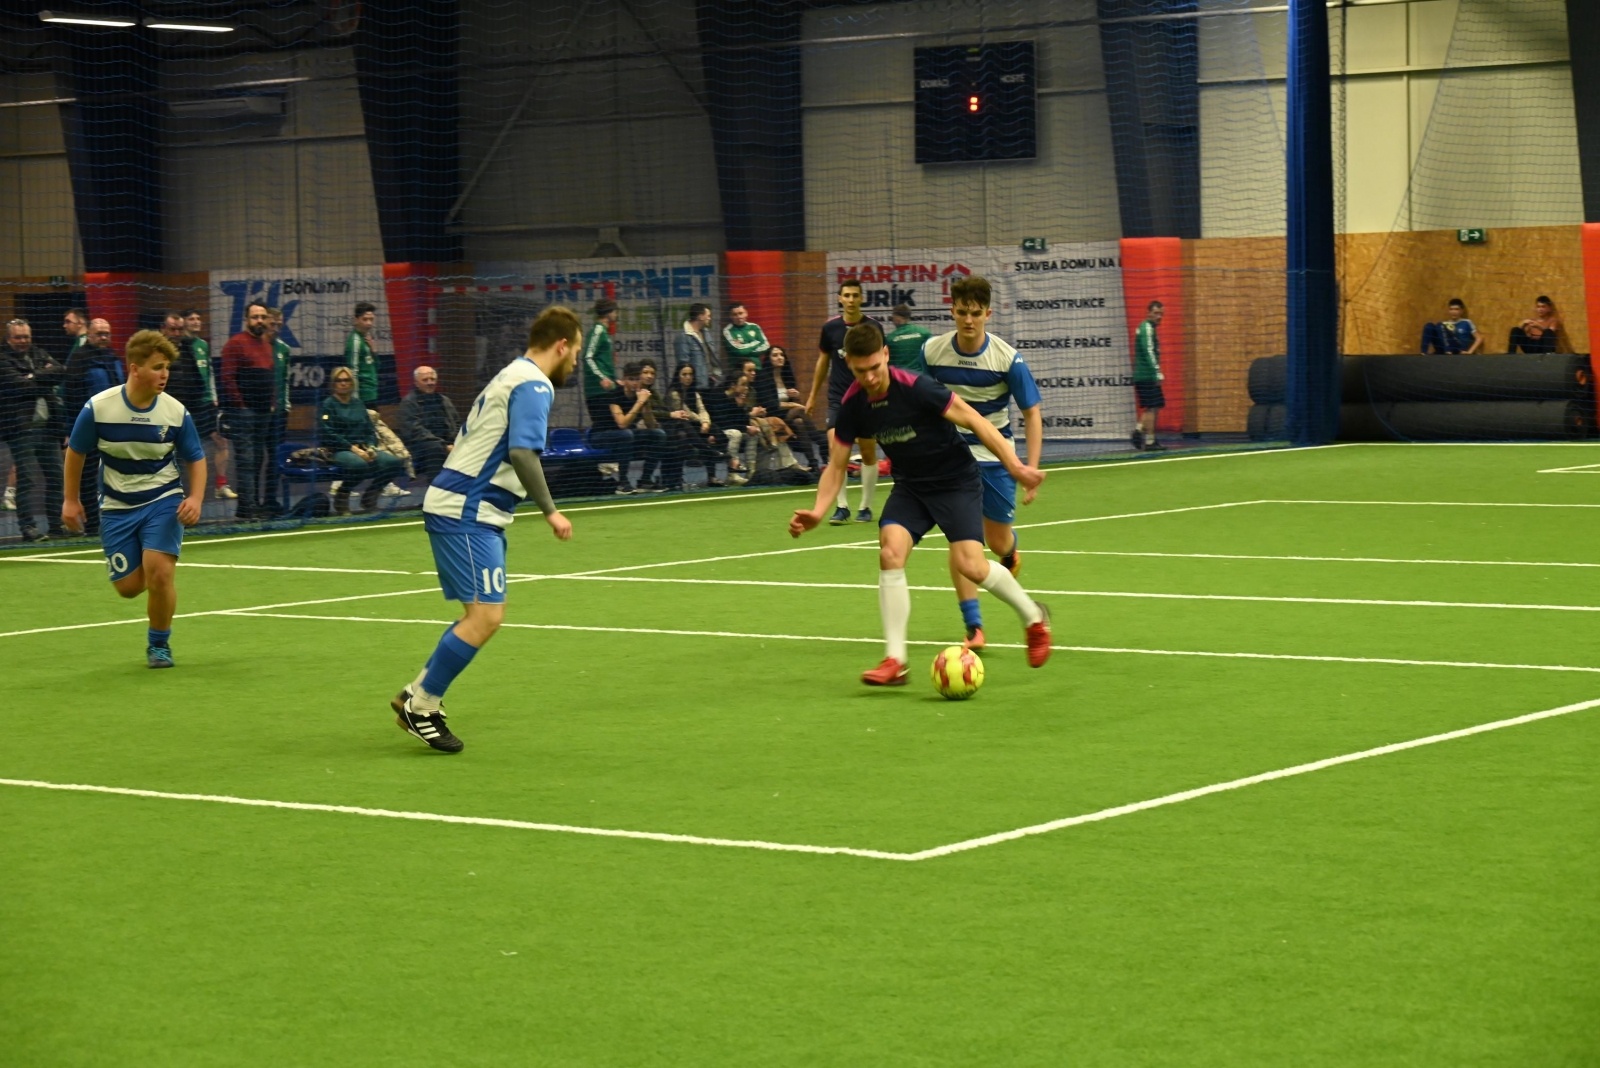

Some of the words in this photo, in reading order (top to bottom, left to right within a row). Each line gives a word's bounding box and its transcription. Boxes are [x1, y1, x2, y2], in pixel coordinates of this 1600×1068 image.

[1015, 261, 1058, 271] STAVBA
[1061, 259, 1096, 269] DOMU
[1099, 258, 1115, 267] NA
[837, 264, 937, 284] MARTIN
[1016, 298, 1105, 310] REKONSTRUKCE
[1016, 336, 1071, 349] ZEDNICKÉ
[1074, 336, 1112, 348] PRÁCE
[1056, 416, 1094, 427] PRÁCE
[482, 567, 505, 594] 10
